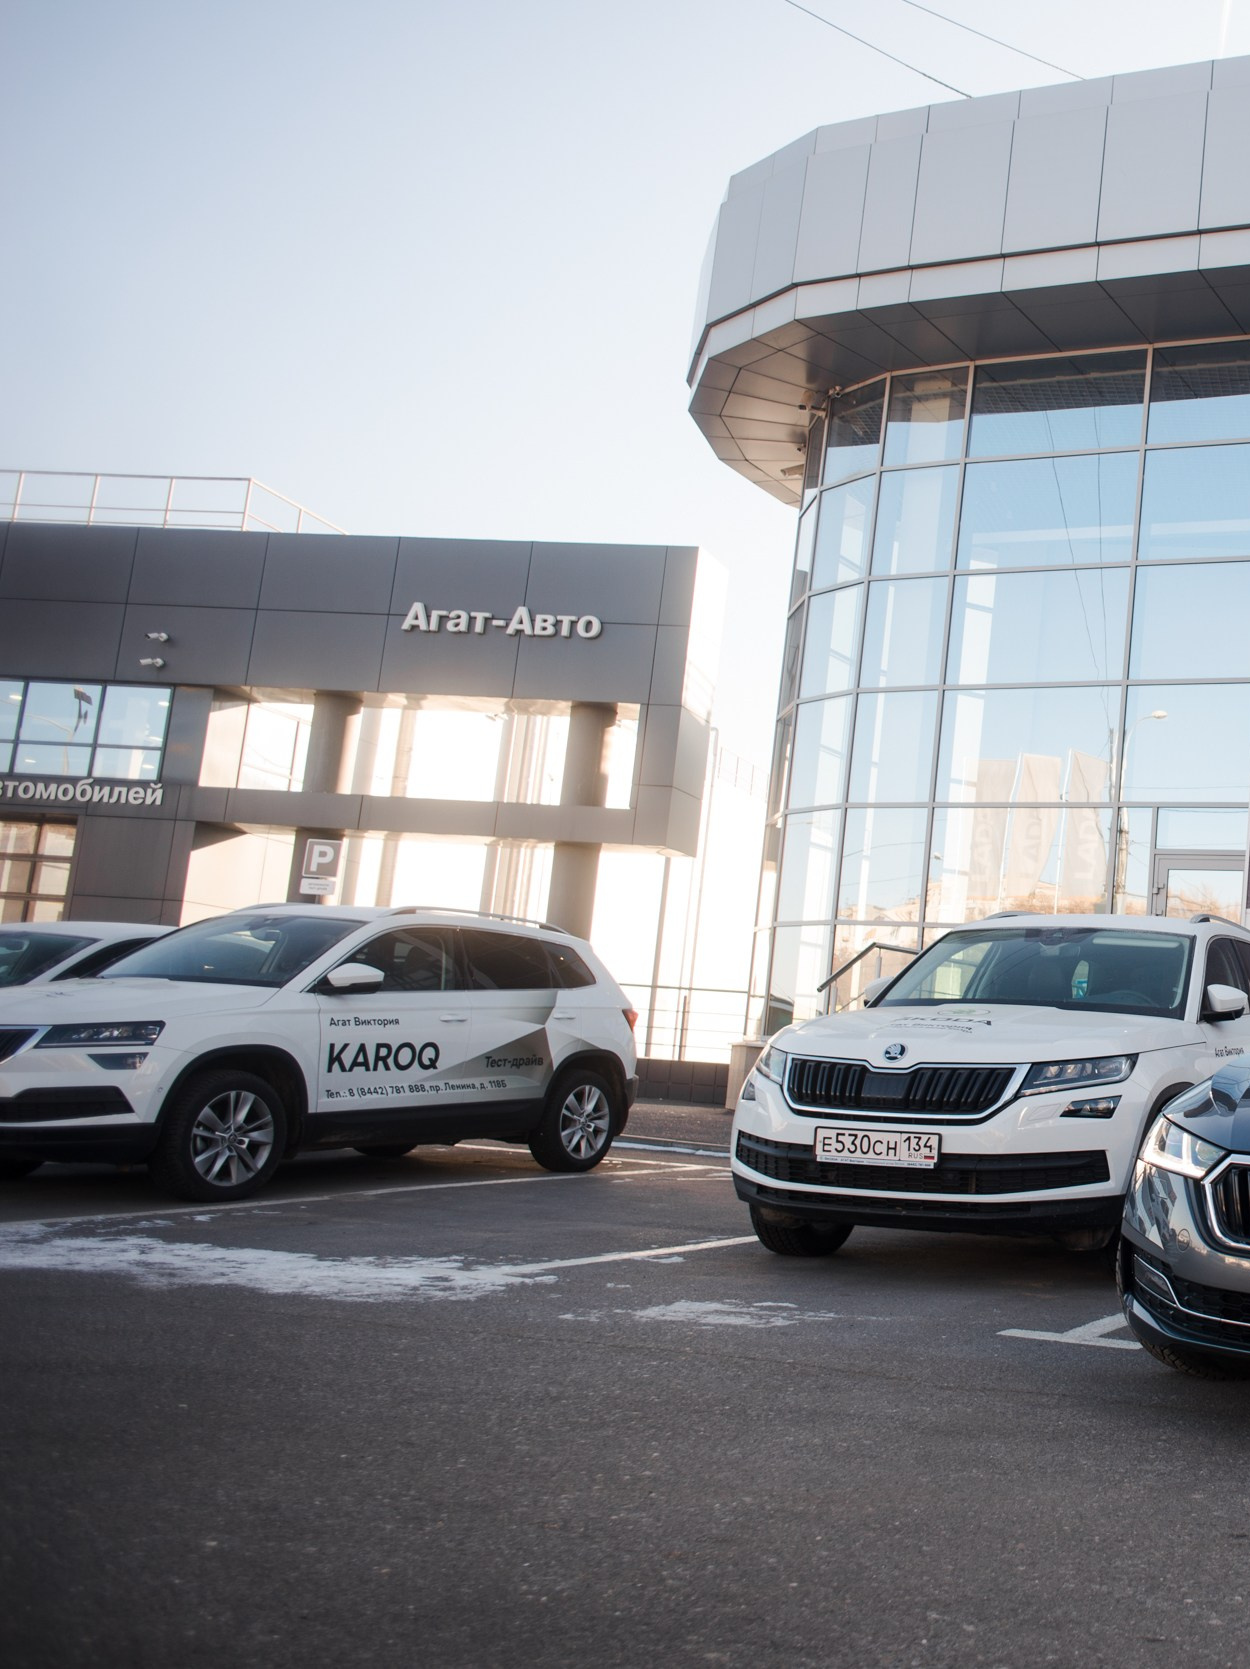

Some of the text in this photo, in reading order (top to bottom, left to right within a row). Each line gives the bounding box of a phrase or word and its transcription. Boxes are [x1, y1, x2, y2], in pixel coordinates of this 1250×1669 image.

[401, 601, 603, 640] Агат-Авто
[0, 778, 164, 806] томобилей
[310, 844, 335, 872] P
[329, 1016, 400, 1028] Агат Виктория
[326, 1041, 440, 1074] KAROQ
[484, 1054, 544, 1069] Тест-драйв
[348, 1087, 355, 1097] 8
[357, 1085, 388, 1098] (8442)
[903, 1135, 934, 1154] 134
[908, 1152, 924, 1160] RUS
